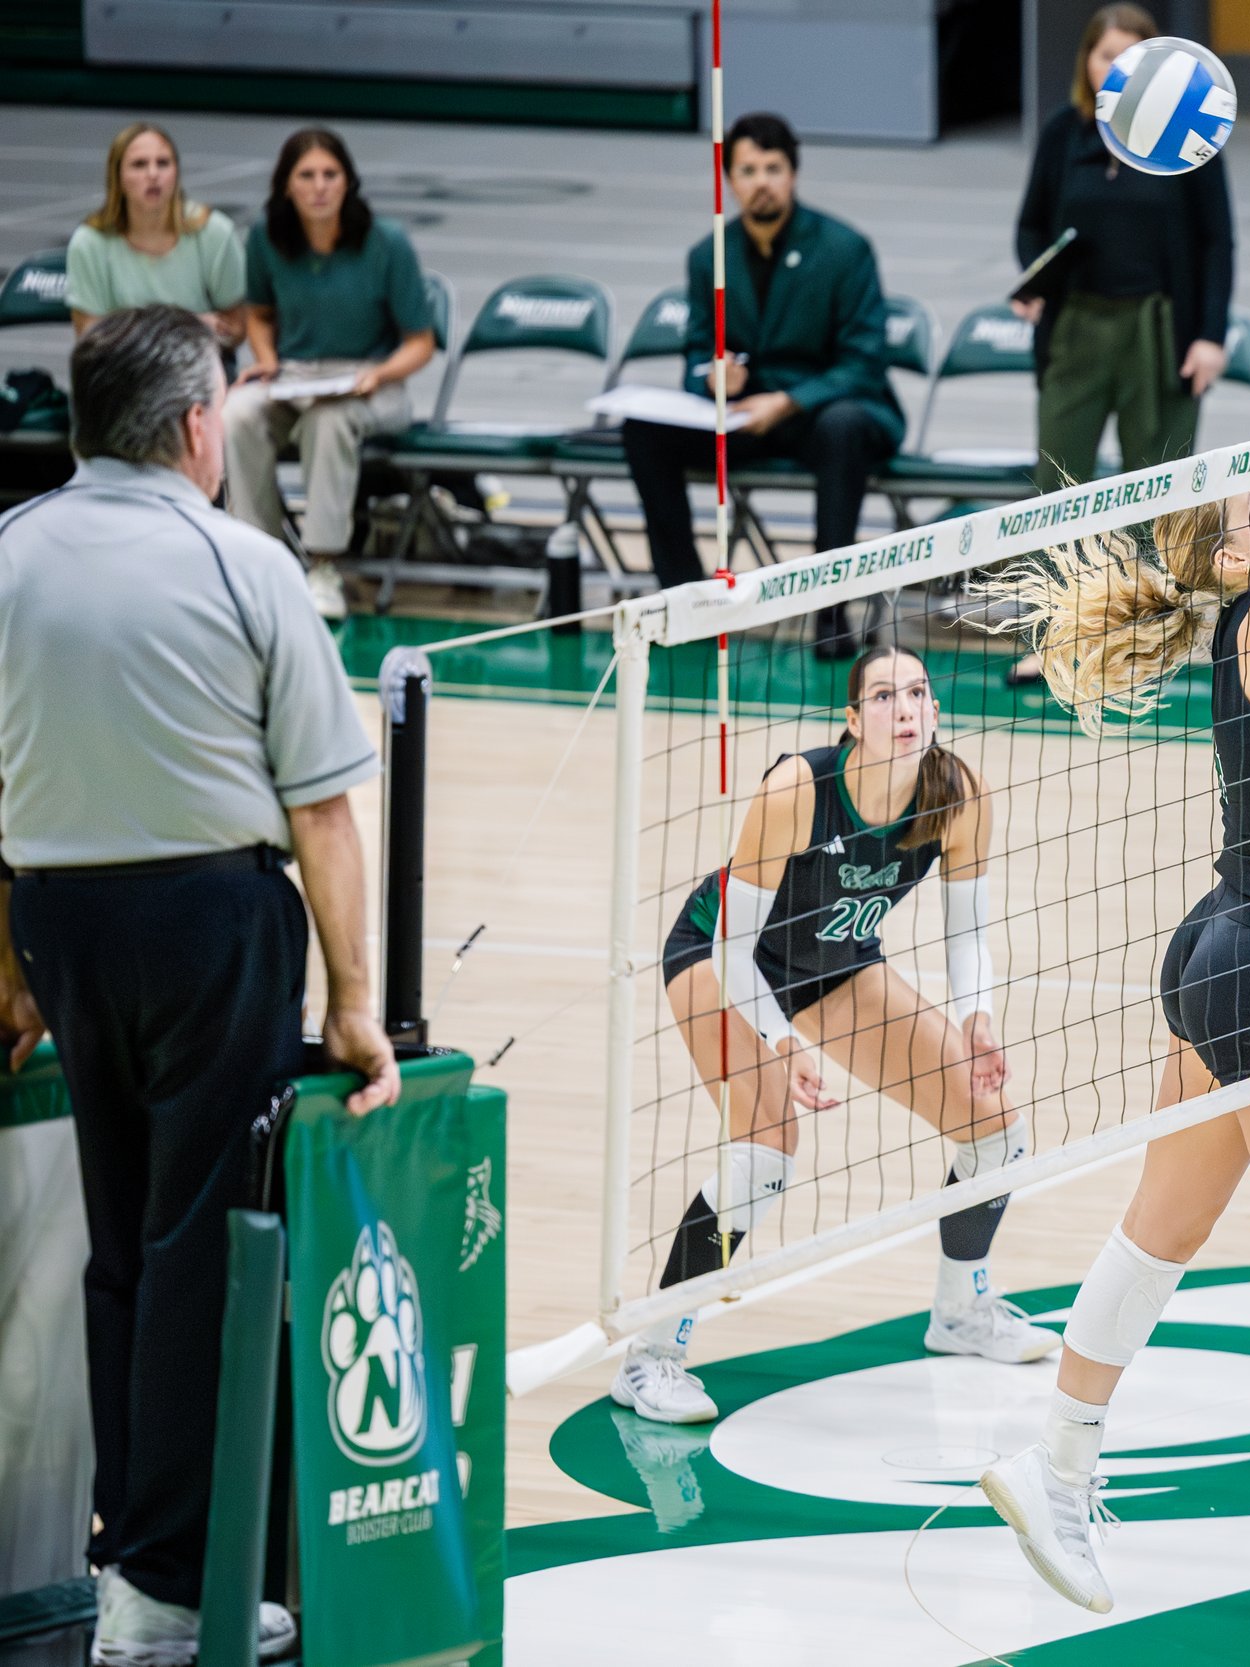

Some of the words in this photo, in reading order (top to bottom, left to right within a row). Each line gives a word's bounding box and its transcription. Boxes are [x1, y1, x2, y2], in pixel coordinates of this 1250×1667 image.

[997, 494, 1090, 540] NORTHWEST
[1091, 473, 1172, 515] BEARCATS
[757, 557, 852, 604] NORTHWEST
[854, 535, 934, 578] BEARCATS
[815, 895, 892, 941] 20
